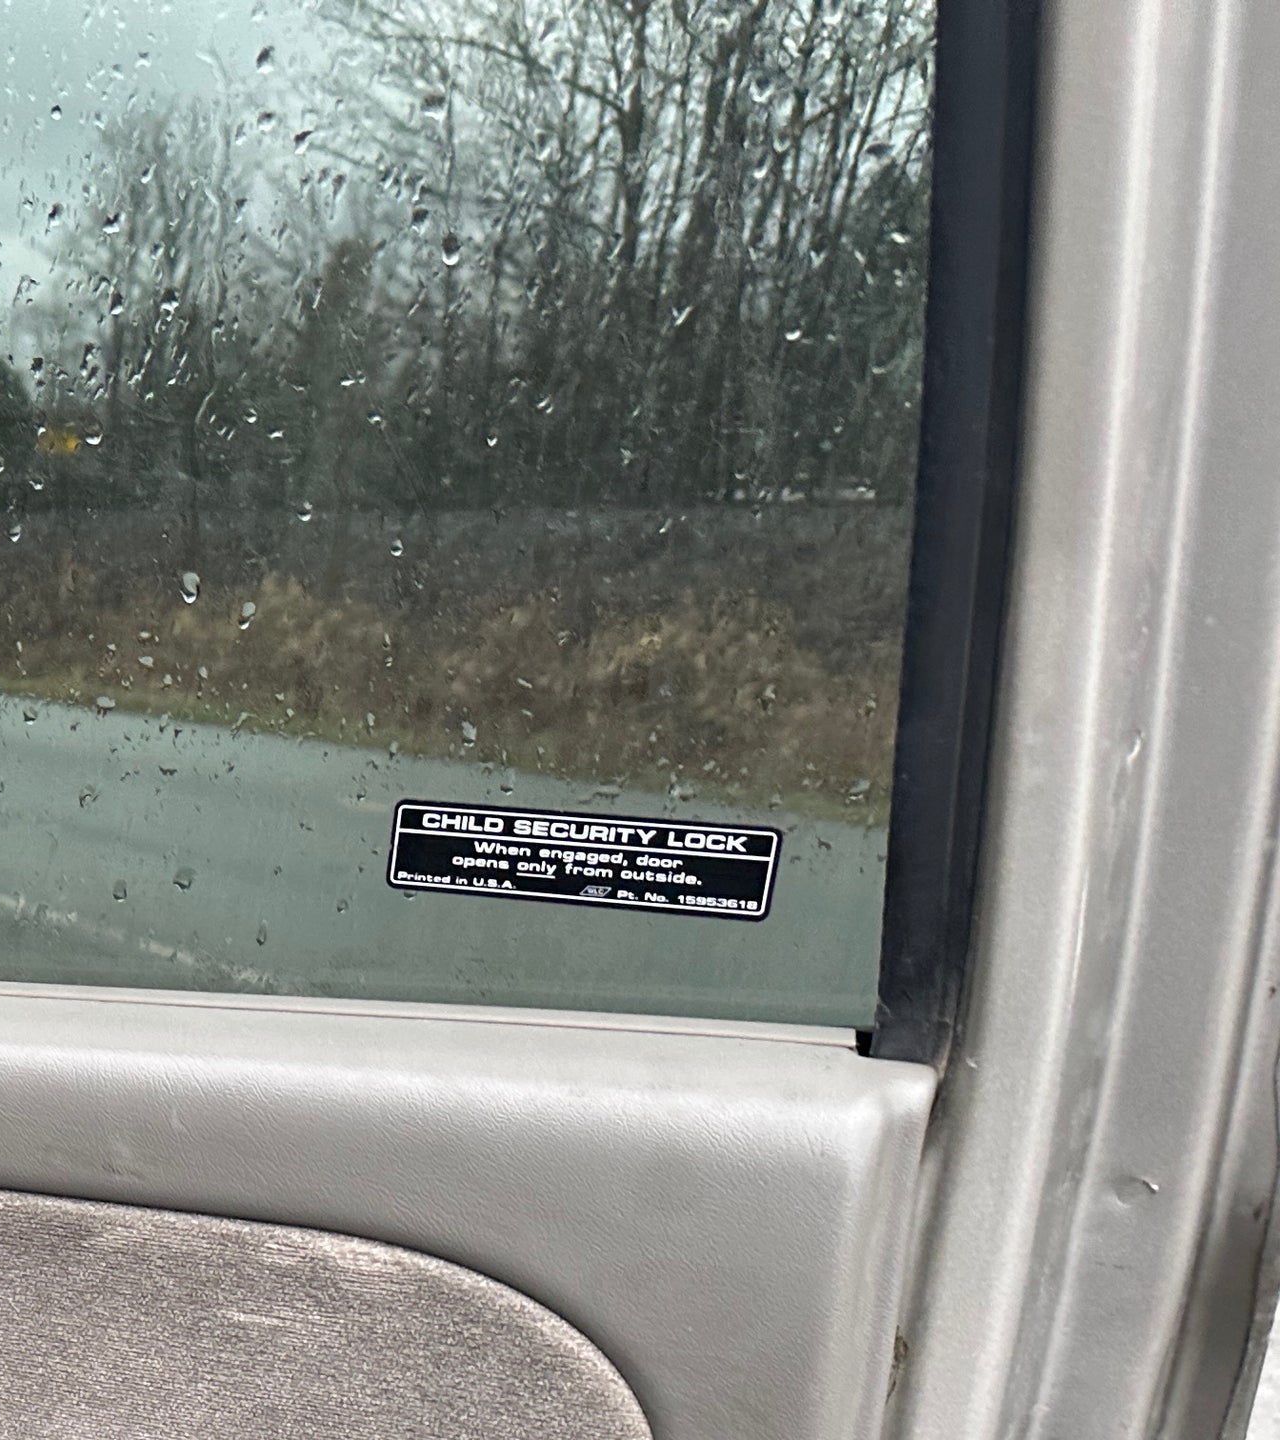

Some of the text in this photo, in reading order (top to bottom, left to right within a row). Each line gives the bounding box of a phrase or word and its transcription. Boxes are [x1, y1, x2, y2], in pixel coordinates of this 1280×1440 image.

[422, 813, 748, 853] CHILD SECURITY LOCK
[474, 841, 683, 869] When engaged, door
[397, 871, 517, 889] Printed in U.S.A.
[452, 856, 703, 886] opens only from outside.
[617, 889, 639, 900] Pt.
[644, 892, 669, 903] No.
